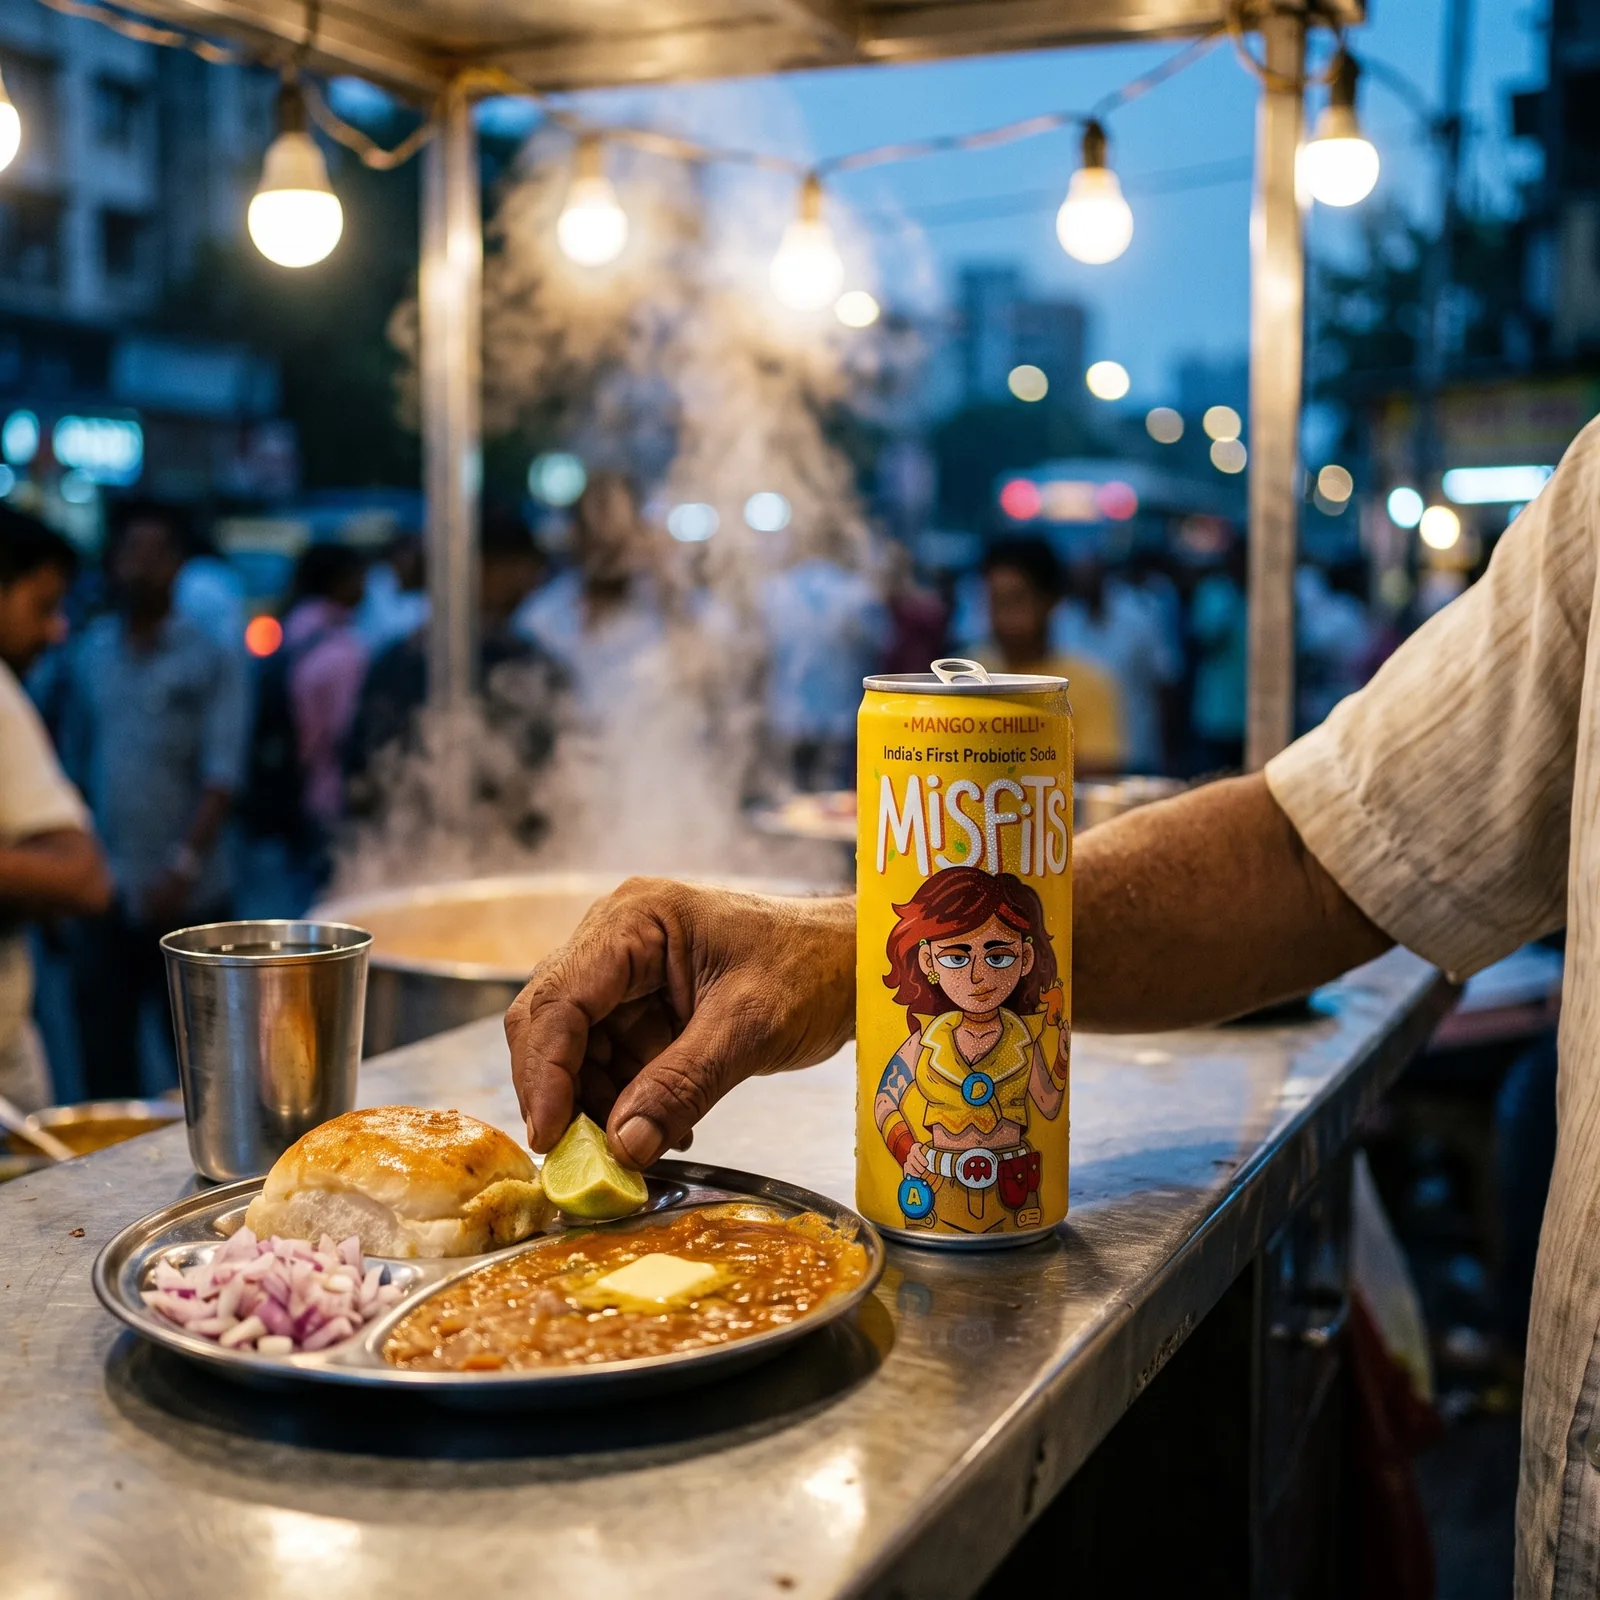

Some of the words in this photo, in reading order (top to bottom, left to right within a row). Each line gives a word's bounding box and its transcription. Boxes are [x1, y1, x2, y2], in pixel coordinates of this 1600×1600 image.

[911, 716, 975, 733] MANGO
[991, 716, 1039, 733] CHILLI
[883, 745, 923, 761] India's
[926, 747, 959, 762] First
[963, 748, 1026, 763] Probiotic
[1030, 746, 1056, 761] Soda
[906, 1187, 922, 1206] A
